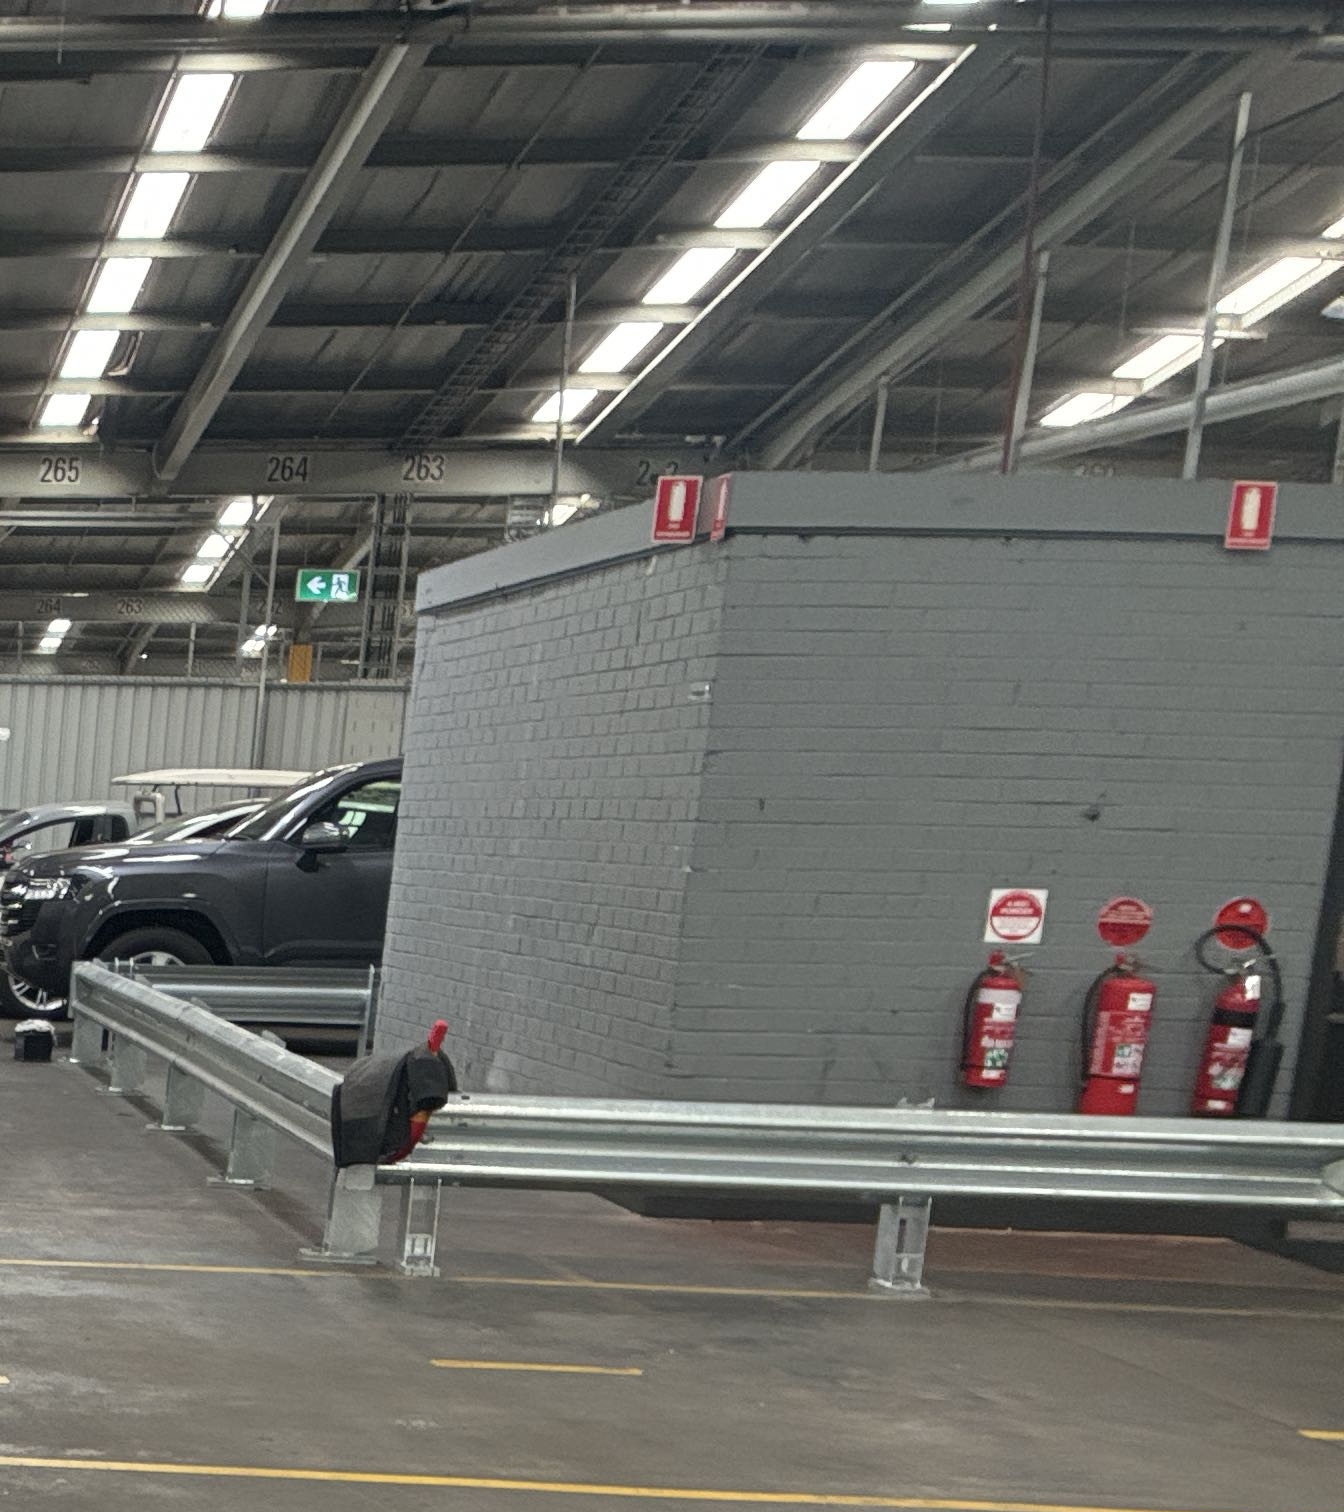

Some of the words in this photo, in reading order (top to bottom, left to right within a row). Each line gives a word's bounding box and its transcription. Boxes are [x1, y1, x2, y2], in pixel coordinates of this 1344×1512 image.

[40, 456, 80, 483] 265
[267, 456, 308, 482] 264
[403, 454, 445, 481] 263
[637, 460, 679, 486] 22
[37, 599, 62, 614] 264
[117, 599, 143, 615] 263
